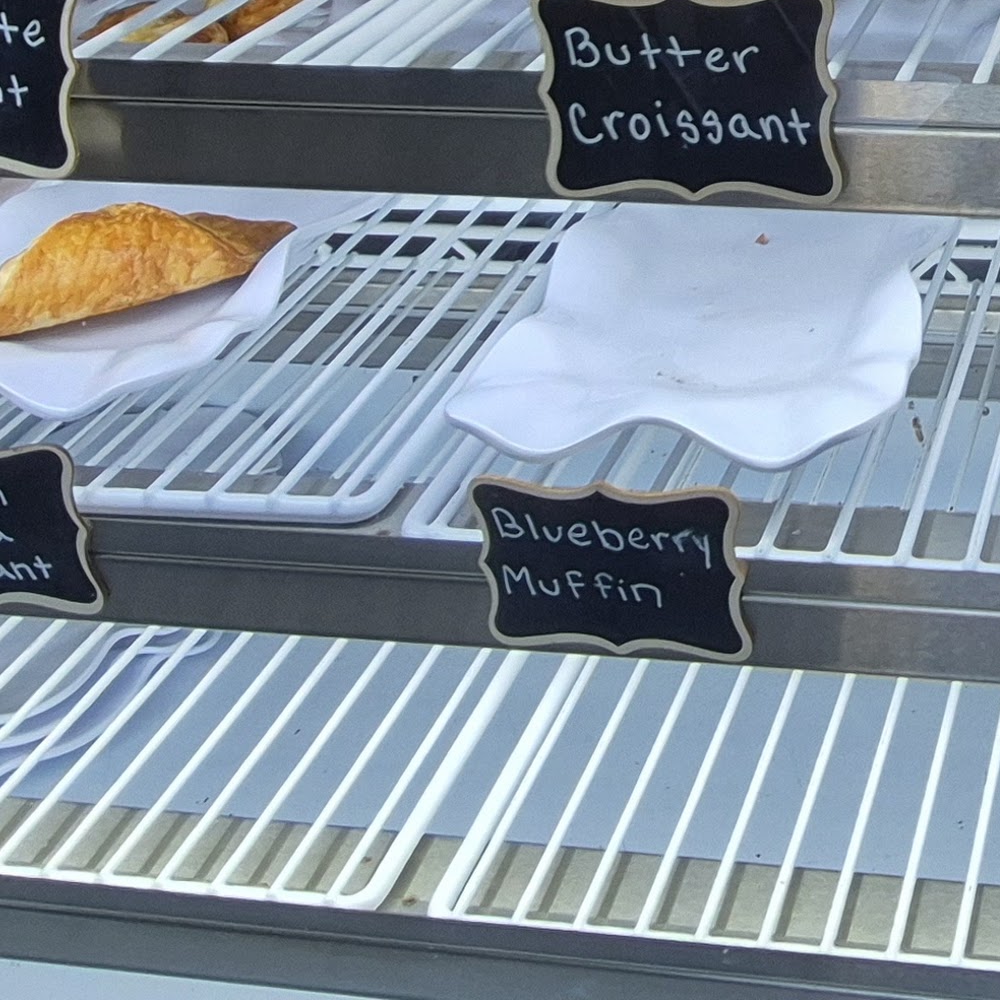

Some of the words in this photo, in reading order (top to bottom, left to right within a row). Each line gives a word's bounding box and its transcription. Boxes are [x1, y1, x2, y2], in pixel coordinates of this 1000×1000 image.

[565, 27, 758, 73] Butter
[568, 100, 812, 146] Croissant
[491, 508, 711, 569] Blueberry
[502, 565, 661, 607] Muffin
